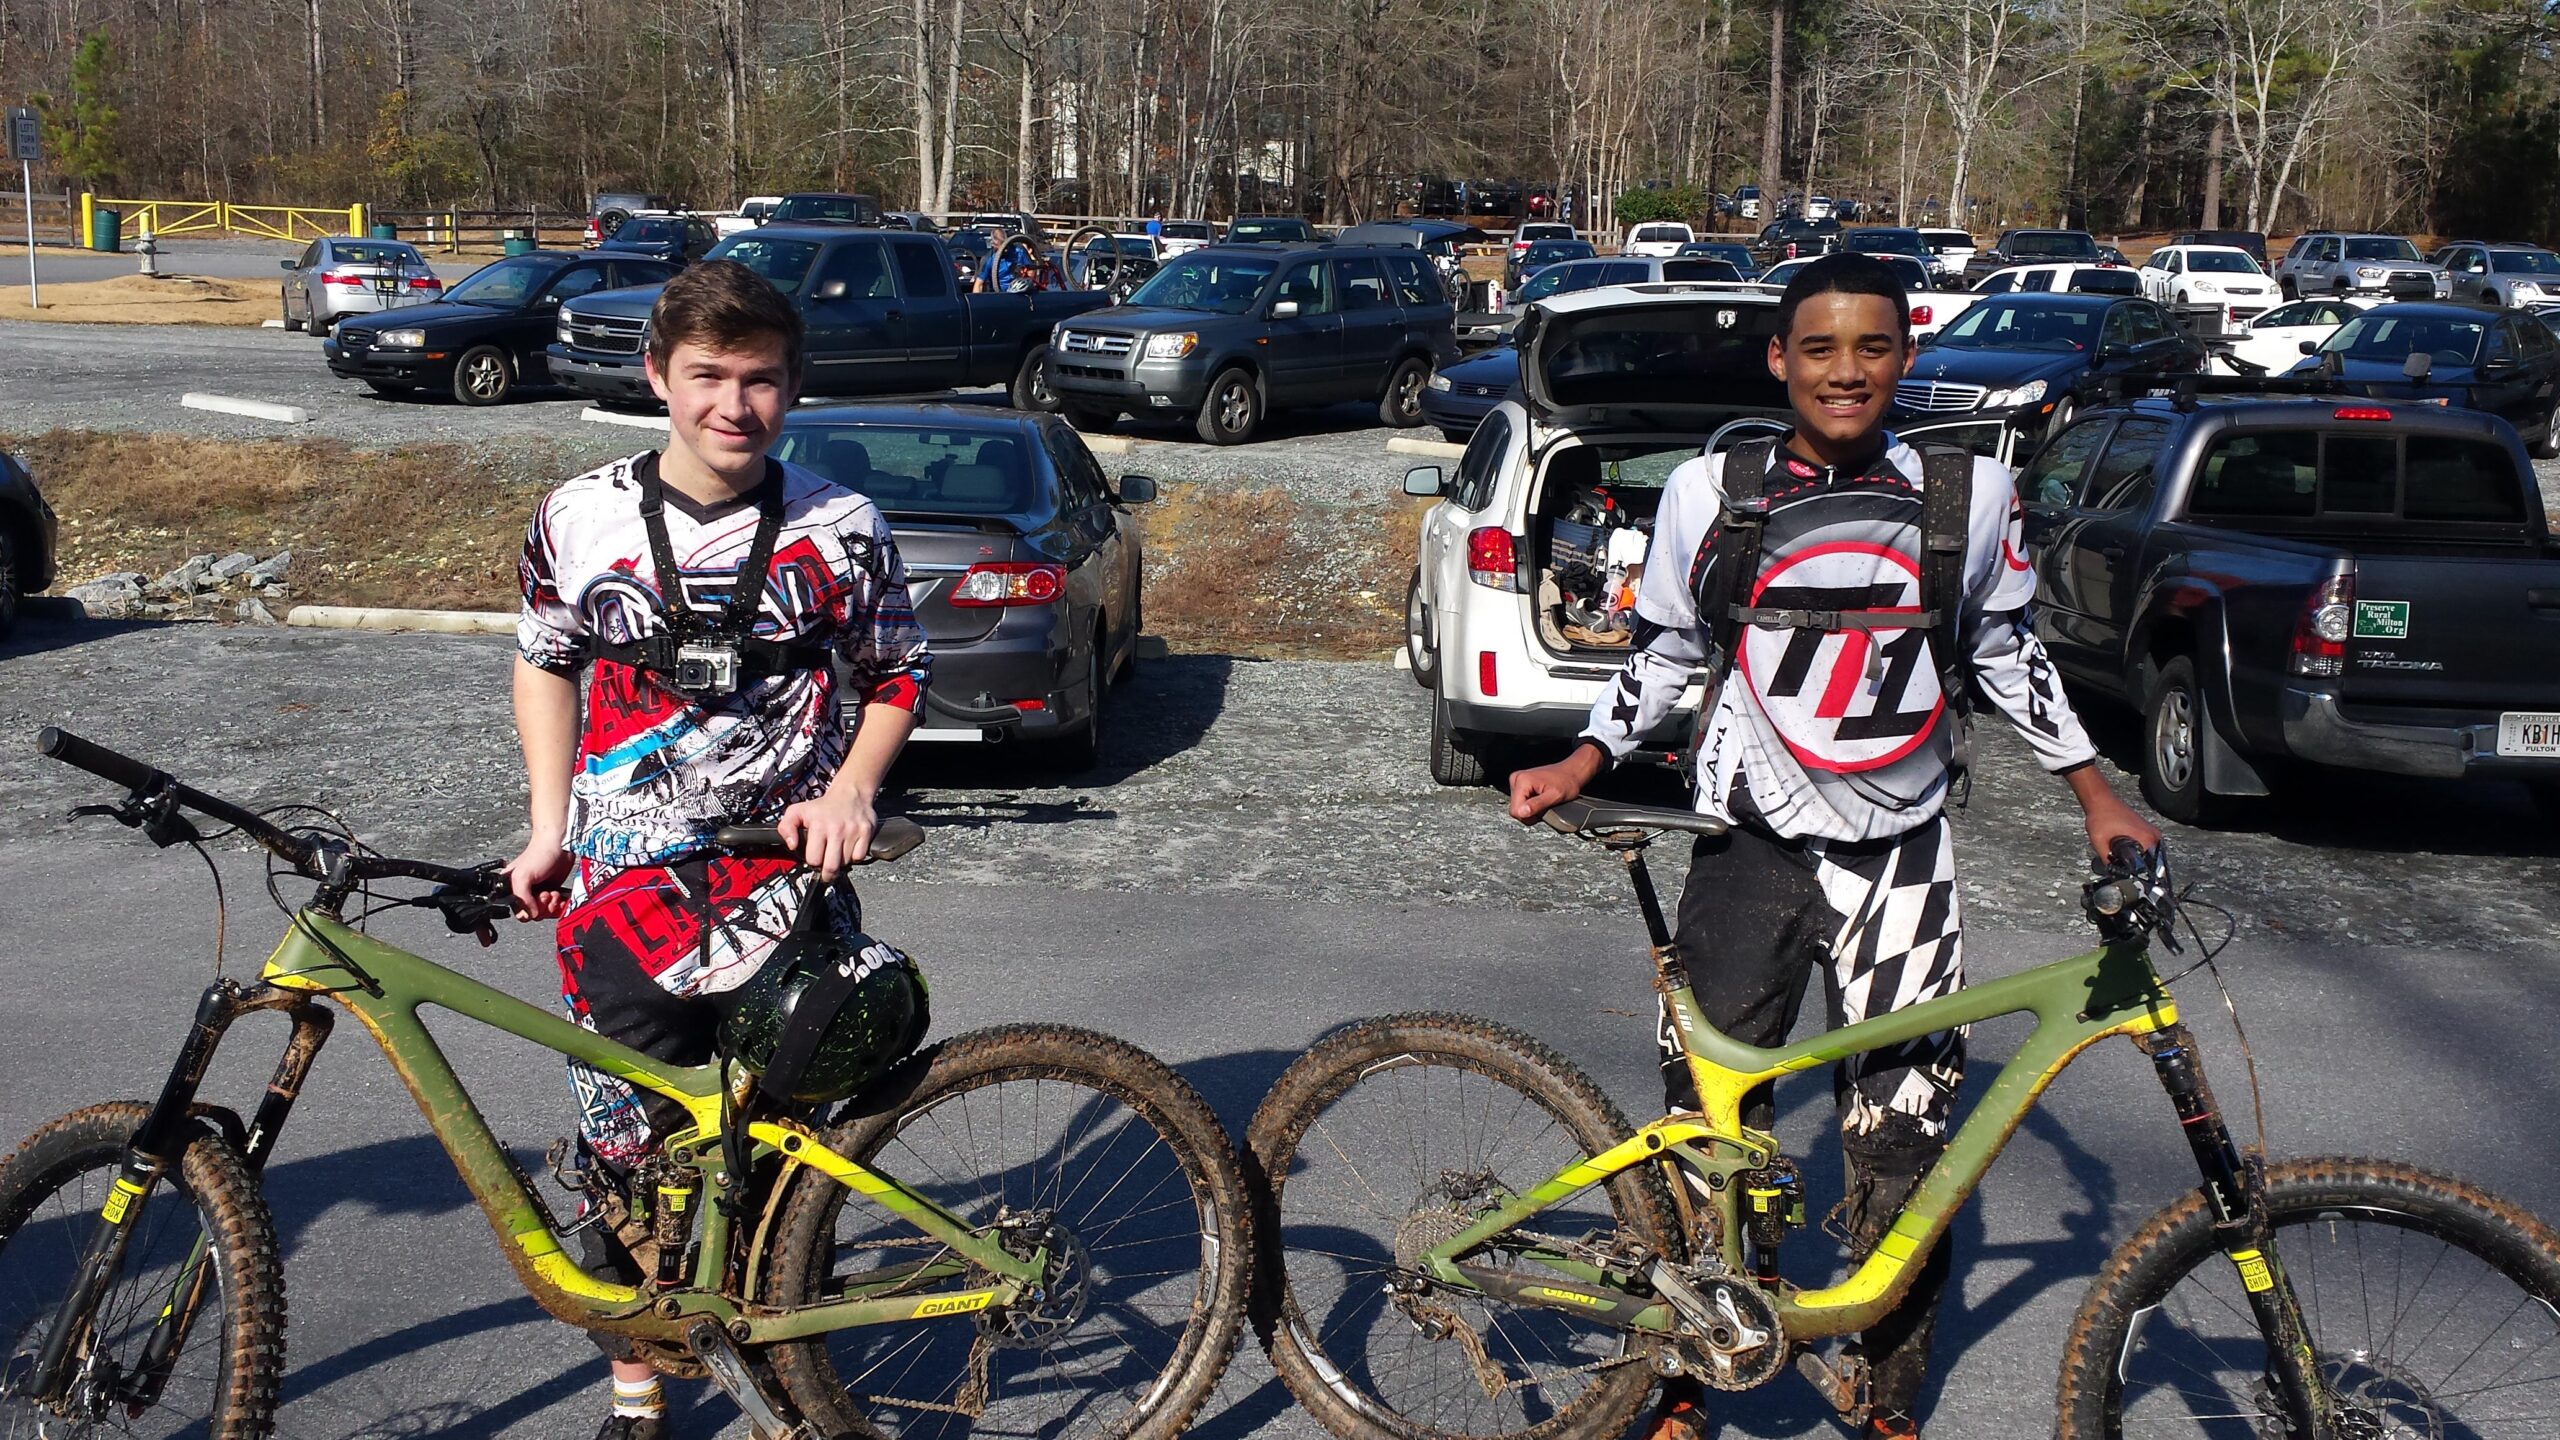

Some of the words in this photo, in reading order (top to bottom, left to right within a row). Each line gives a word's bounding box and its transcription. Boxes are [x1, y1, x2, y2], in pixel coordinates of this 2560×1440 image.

[2360, 603, 2396, 612] Preserve
[2367, 611, 2391, 619] Rural
[2376, 619, 2403, 627] Milton
[2357, 660, 2443, 671] TACOMA
[2240, 1260, 2266, 1277] ROCK
[2247, 1274, 2271, 1289] SHOX
[1542, 1287, 1597, 1305] GIANT
[922, 1297, 984, 1314] GIANT
